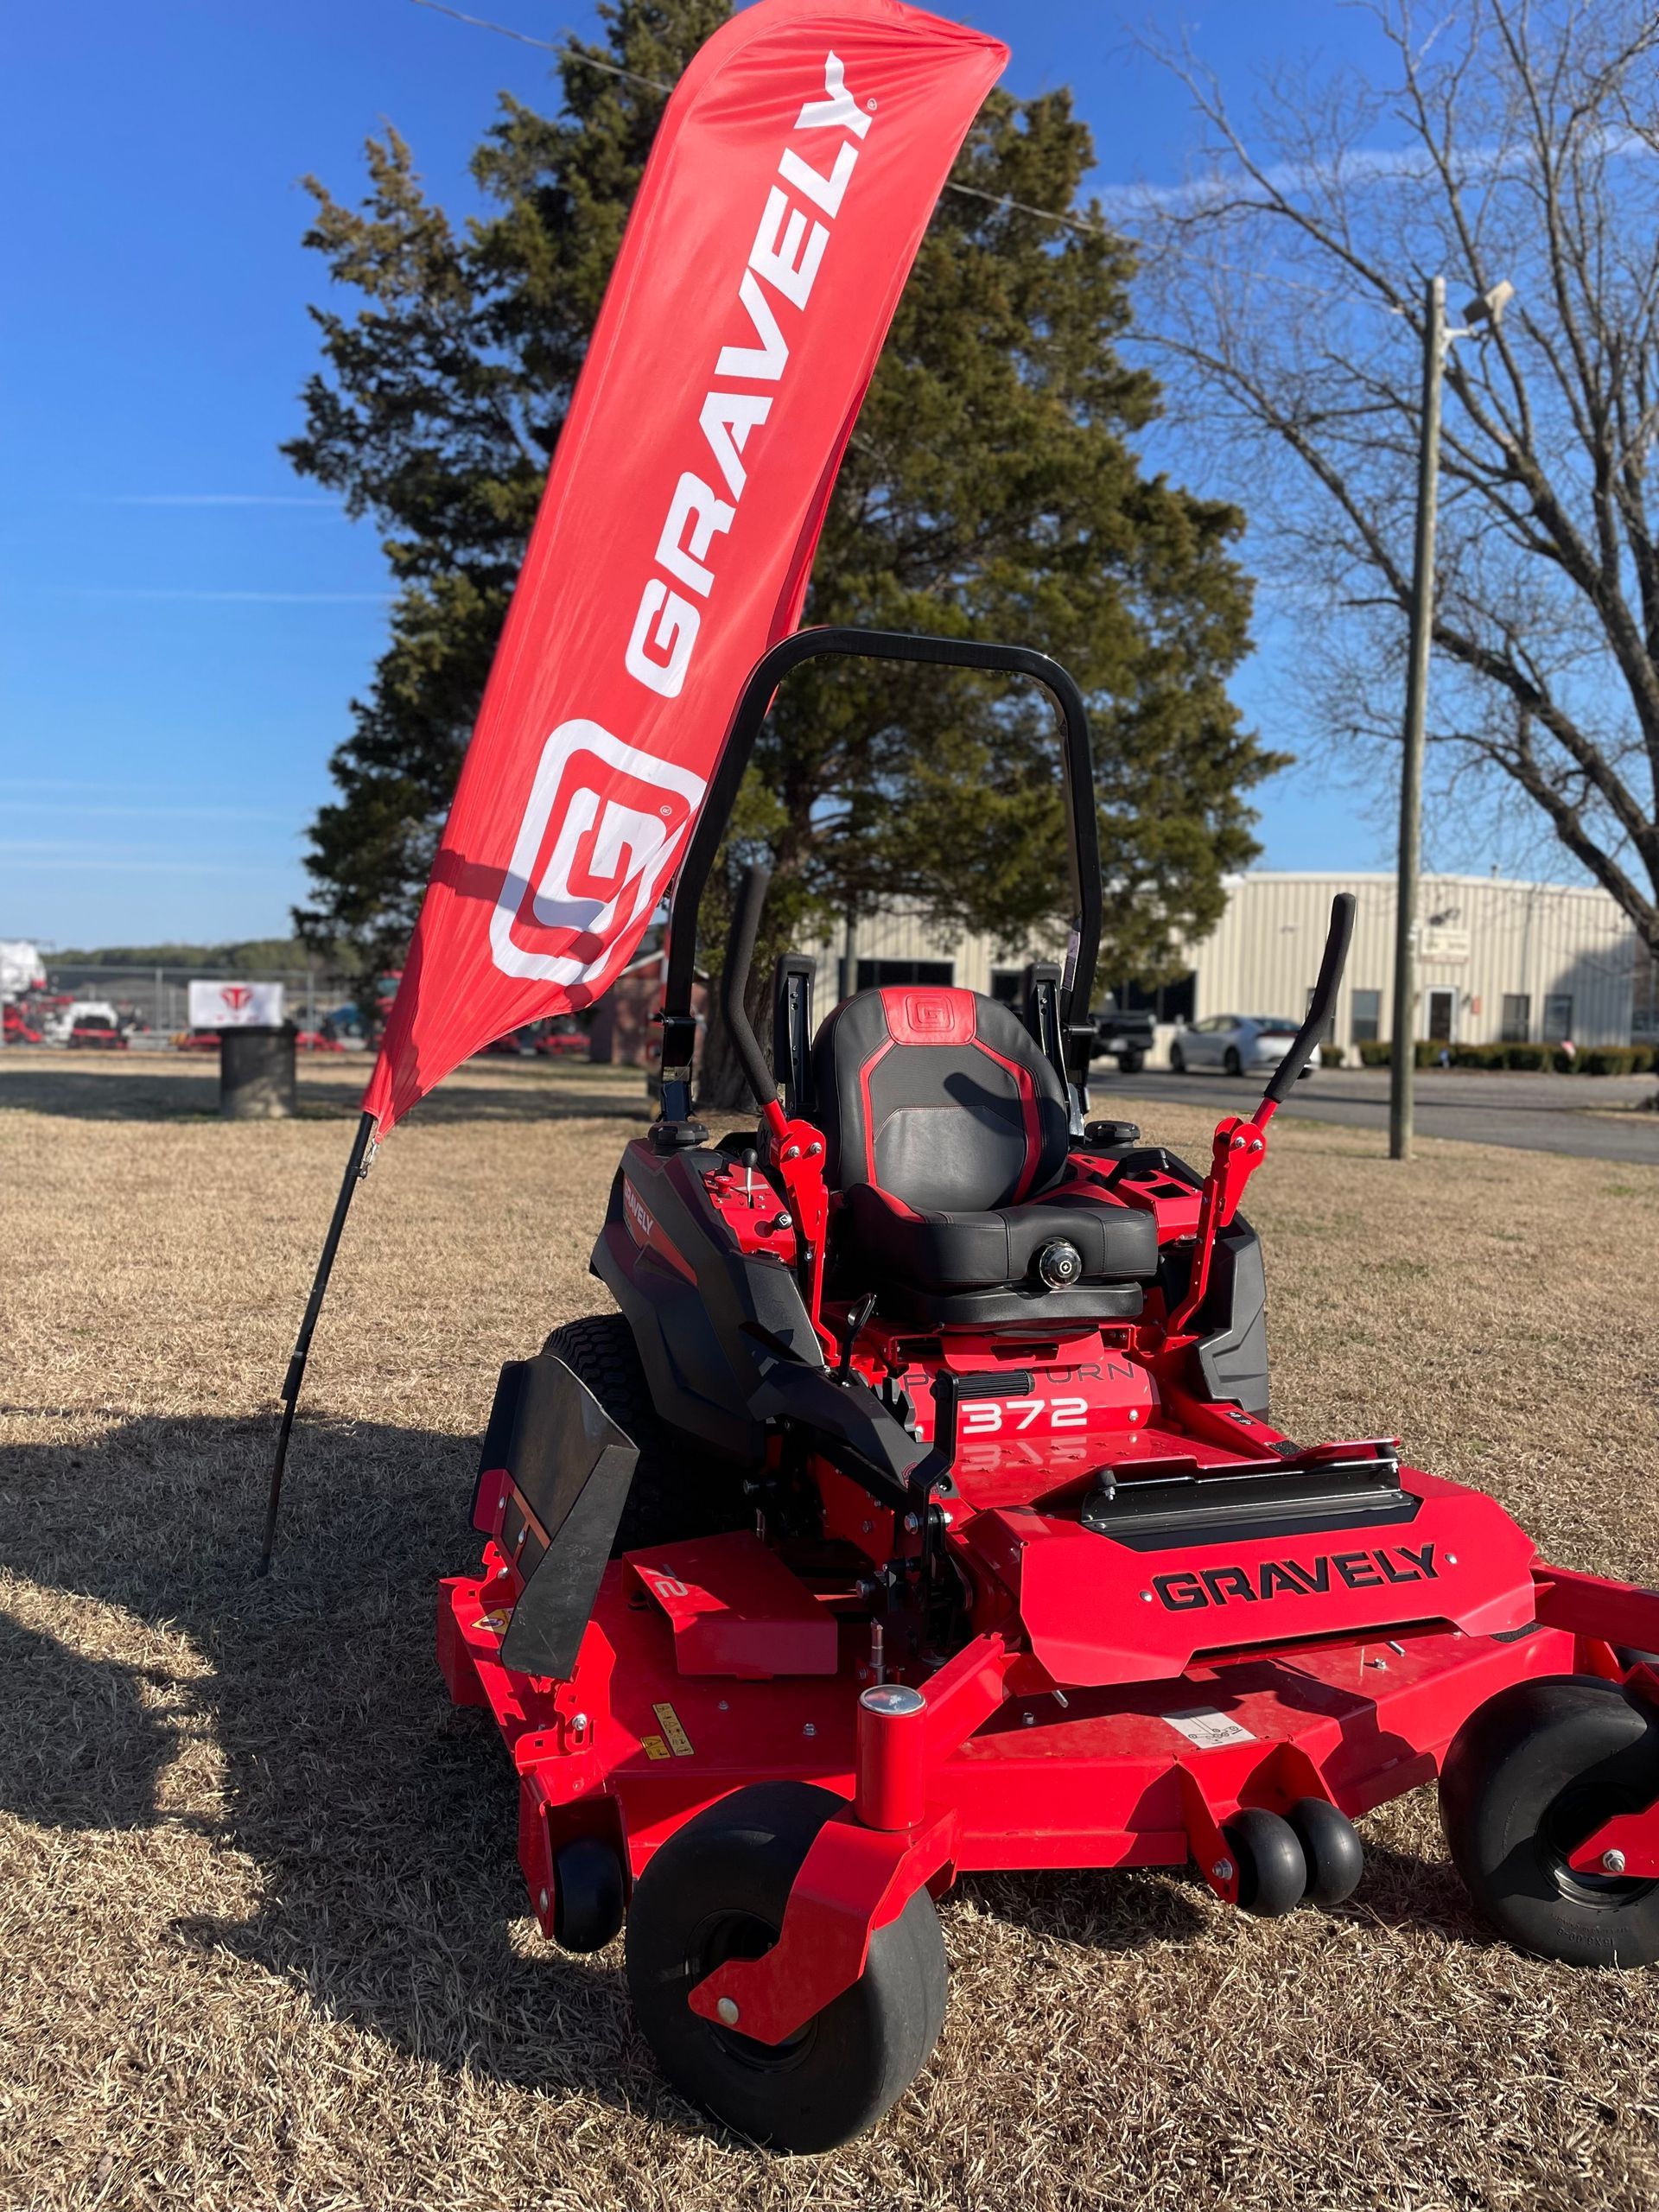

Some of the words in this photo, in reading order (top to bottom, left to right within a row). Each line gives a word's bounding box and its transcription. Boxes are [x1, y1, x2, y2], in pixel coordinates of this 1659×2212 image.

[625, 49, 873, 698] GRAVELY
[962, 1397, 1089, 1434] 372
[1152, 1543, 1440, 1611] GRAVELY
